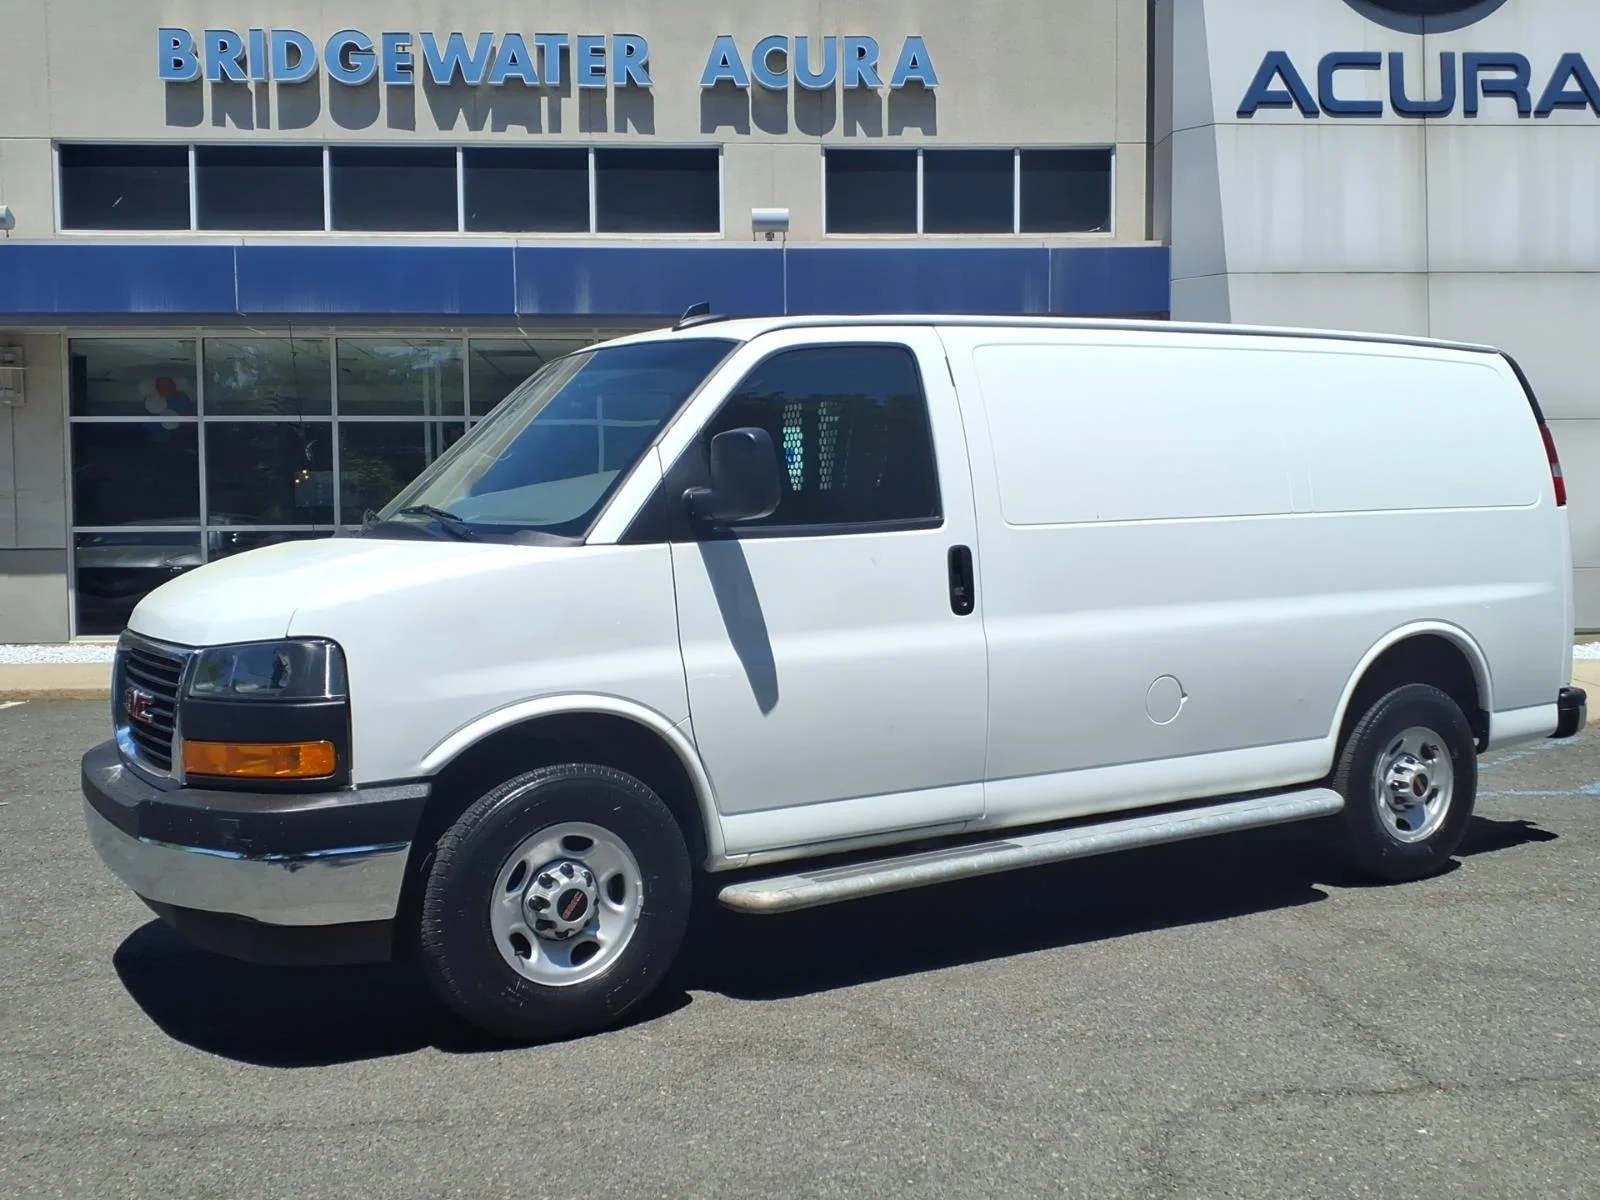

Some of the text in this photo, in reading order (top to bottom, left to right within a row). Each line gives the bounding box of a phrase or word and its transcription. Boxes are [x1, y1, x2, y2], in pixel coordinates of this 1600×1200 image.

[158, 28, 939, 90] BRIDGEWATER ACURA
[1236, 51, 1600, 118] ACURA
